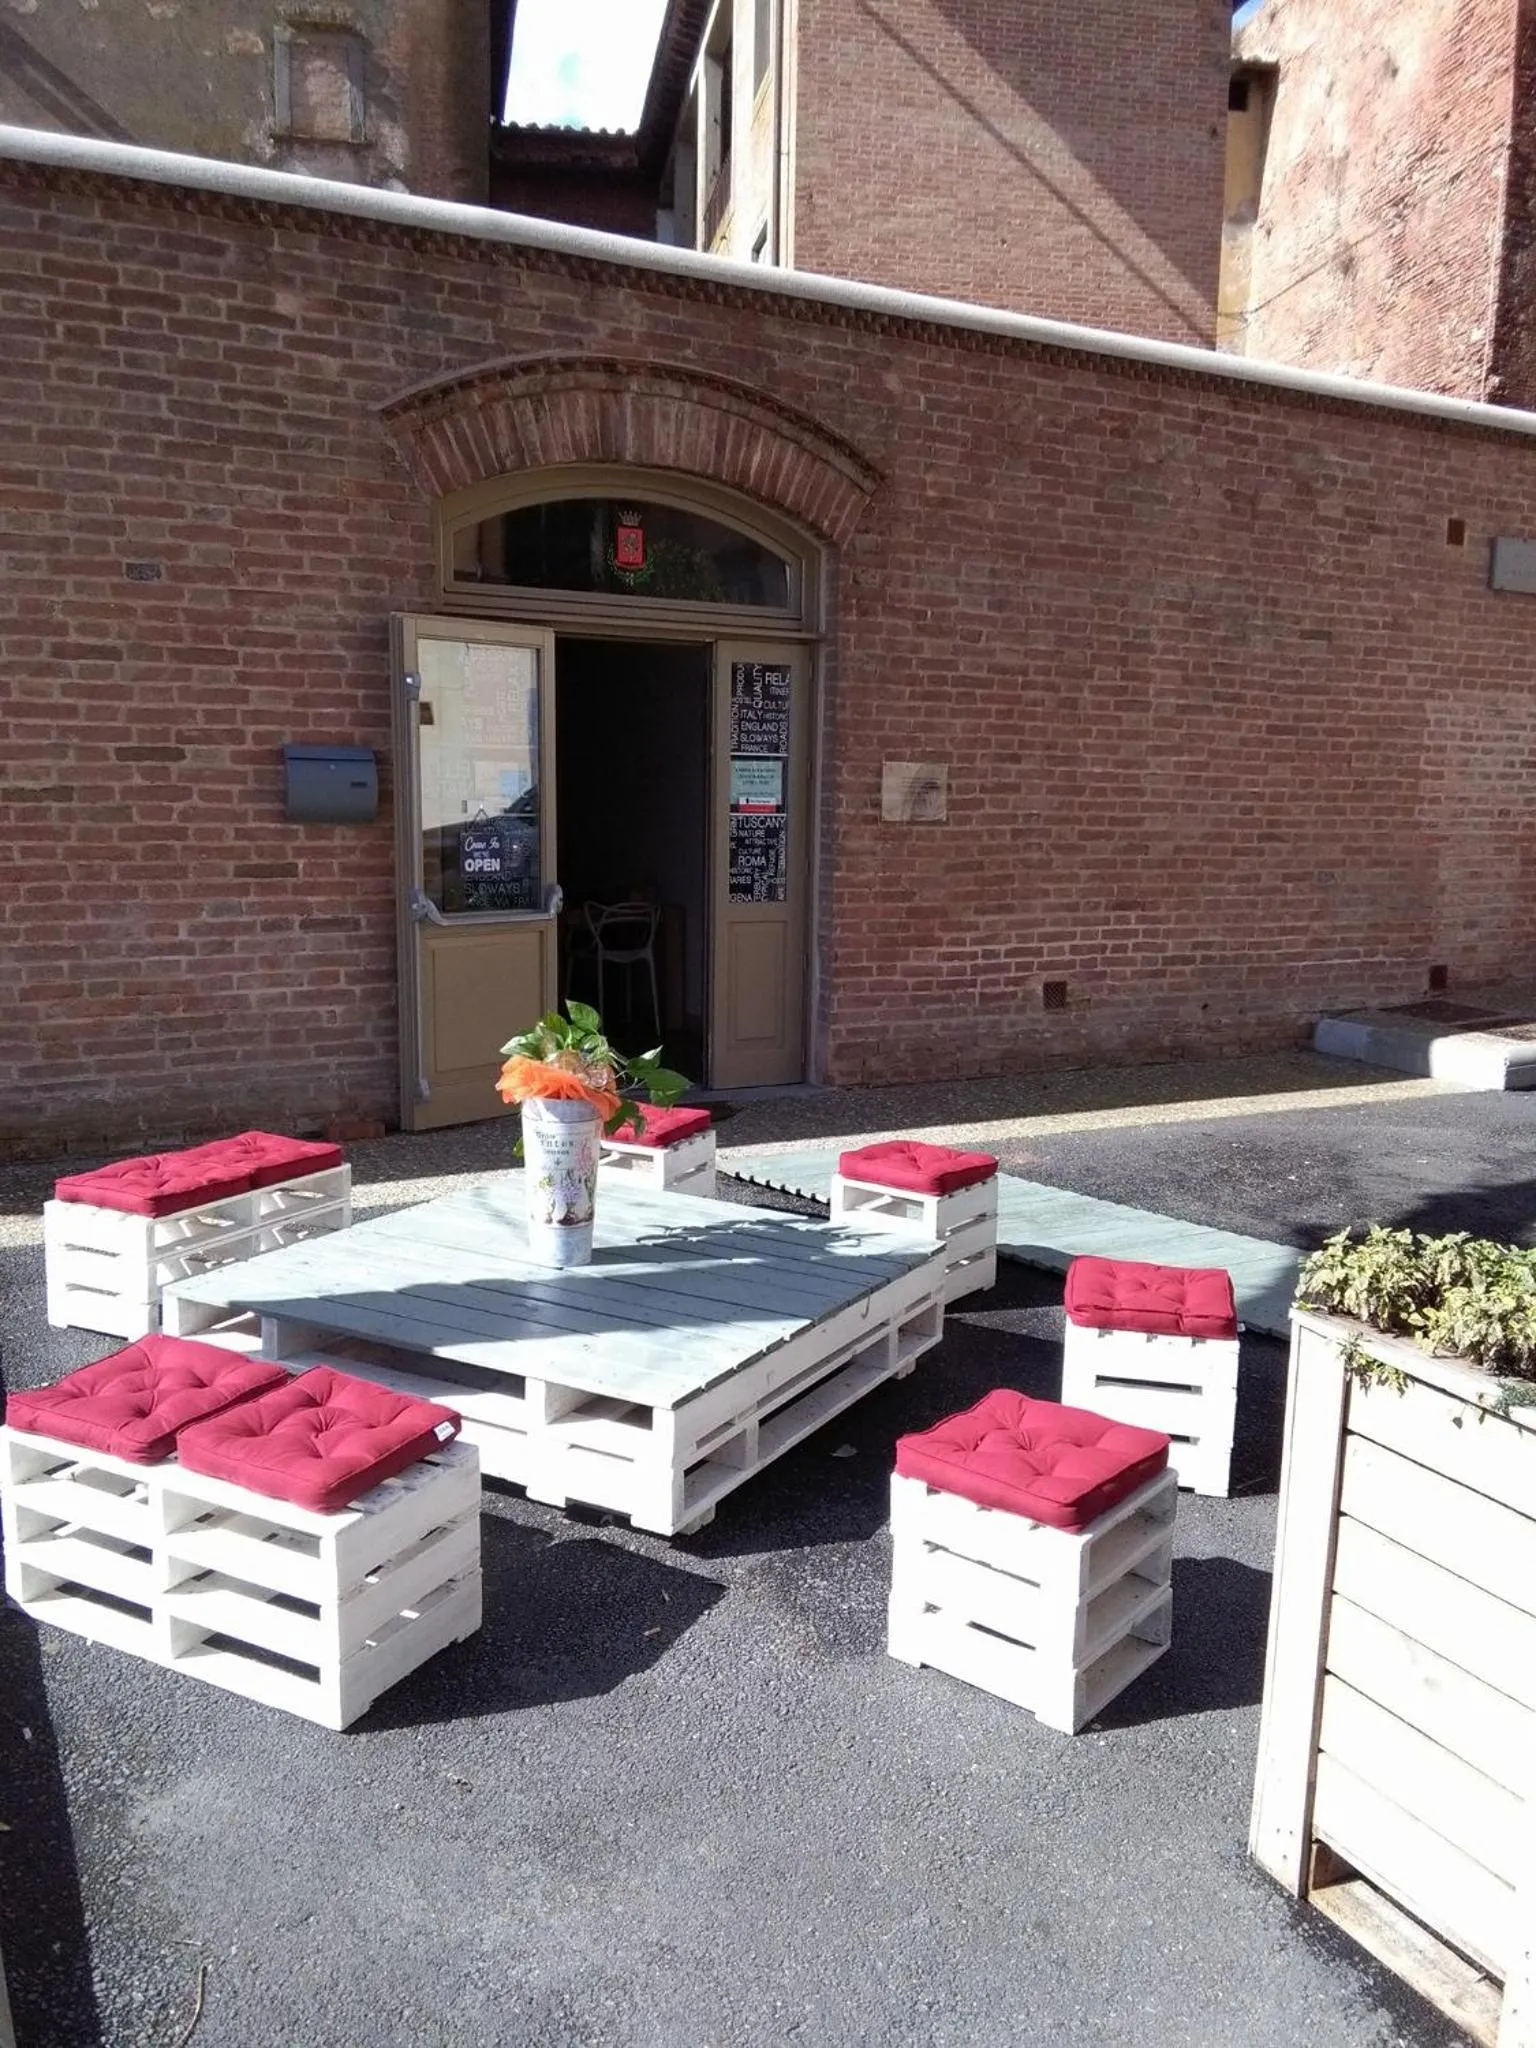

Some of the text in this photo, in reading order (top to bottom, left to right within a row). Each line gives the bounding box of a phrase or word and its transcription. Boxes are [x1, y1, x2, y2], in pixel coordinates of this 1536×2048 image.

[753, 663, 762, 708] QUALITY
[740, 709, 763, 720] ITALY
[731, 703, 739, 750] TRADITION
[740, 721, 779, 732] ENGLAND
[740, 733, 779, 743] SLOWAYS
[779, 721, 787, 753] ROADS
[740, 743, 768, 754] FRANCE
[739, 815, 786, 828] TUSCANY
[738, 829, 765, 838] NATURE
[464, 858, 500, 872] OPEN
[738, 855, 767, 867] ROMA
